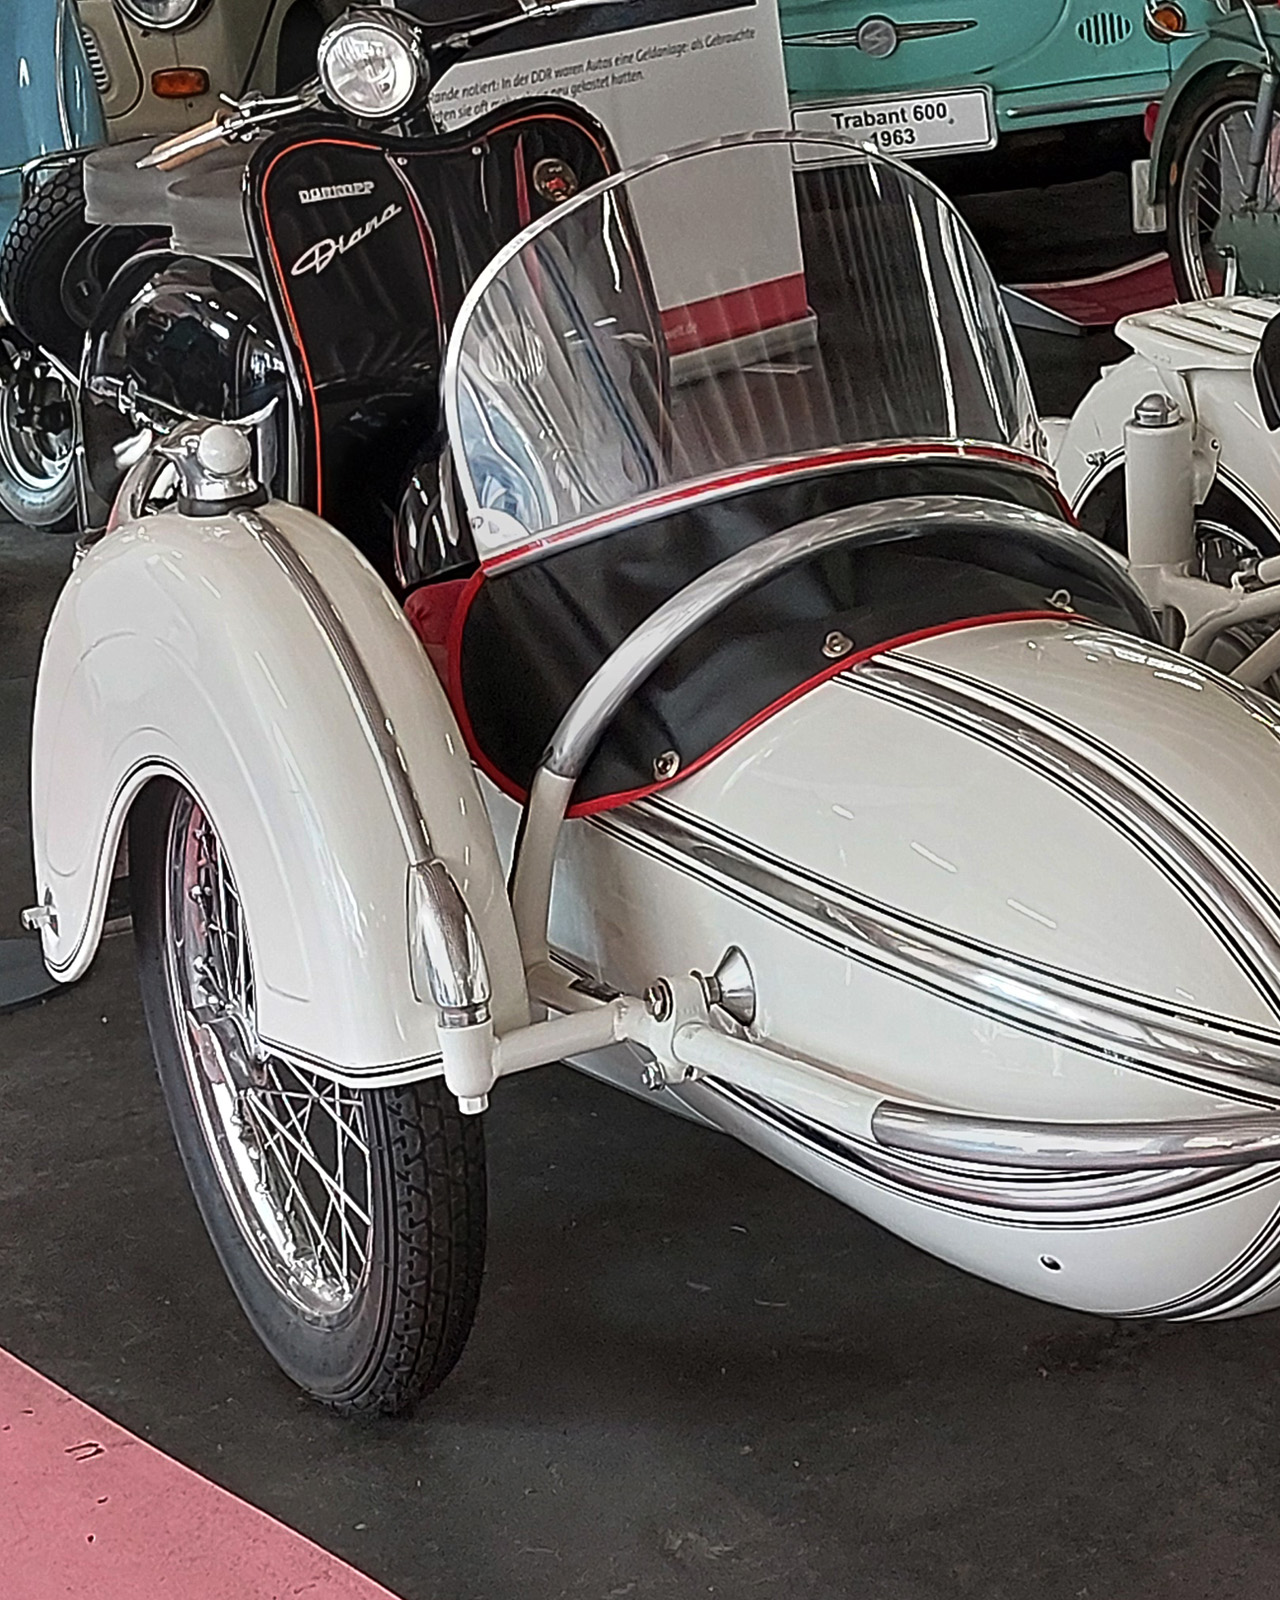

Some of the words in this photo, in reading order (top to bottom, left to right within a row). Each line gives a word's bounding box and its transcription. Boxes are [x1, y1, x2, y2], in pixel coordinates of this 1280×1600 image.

[462, 81, 499, 98] notiert:
[501, 77, 512, 90] In
[514, 73, 529, 88] der
[531, 69, 552, 84] DDR
[554, 63, 584, 78] waren
[586, 57, 613, 72] Autos
[614, 53, 635, 67] eine
[691, 38, 704, 51] als
[705, 28, 755, 49] Gebrauchte
[458, 104, 472, 119] sie
[474, 99, 488, 115] oft
[570, 74, 610, 98] gekostet
[831, 107, 908, 129] Trabant
[913, 102, 947, 122] 600
[870, 128, 916, 148] 1963
[290, 203, 402, 276] Diana
